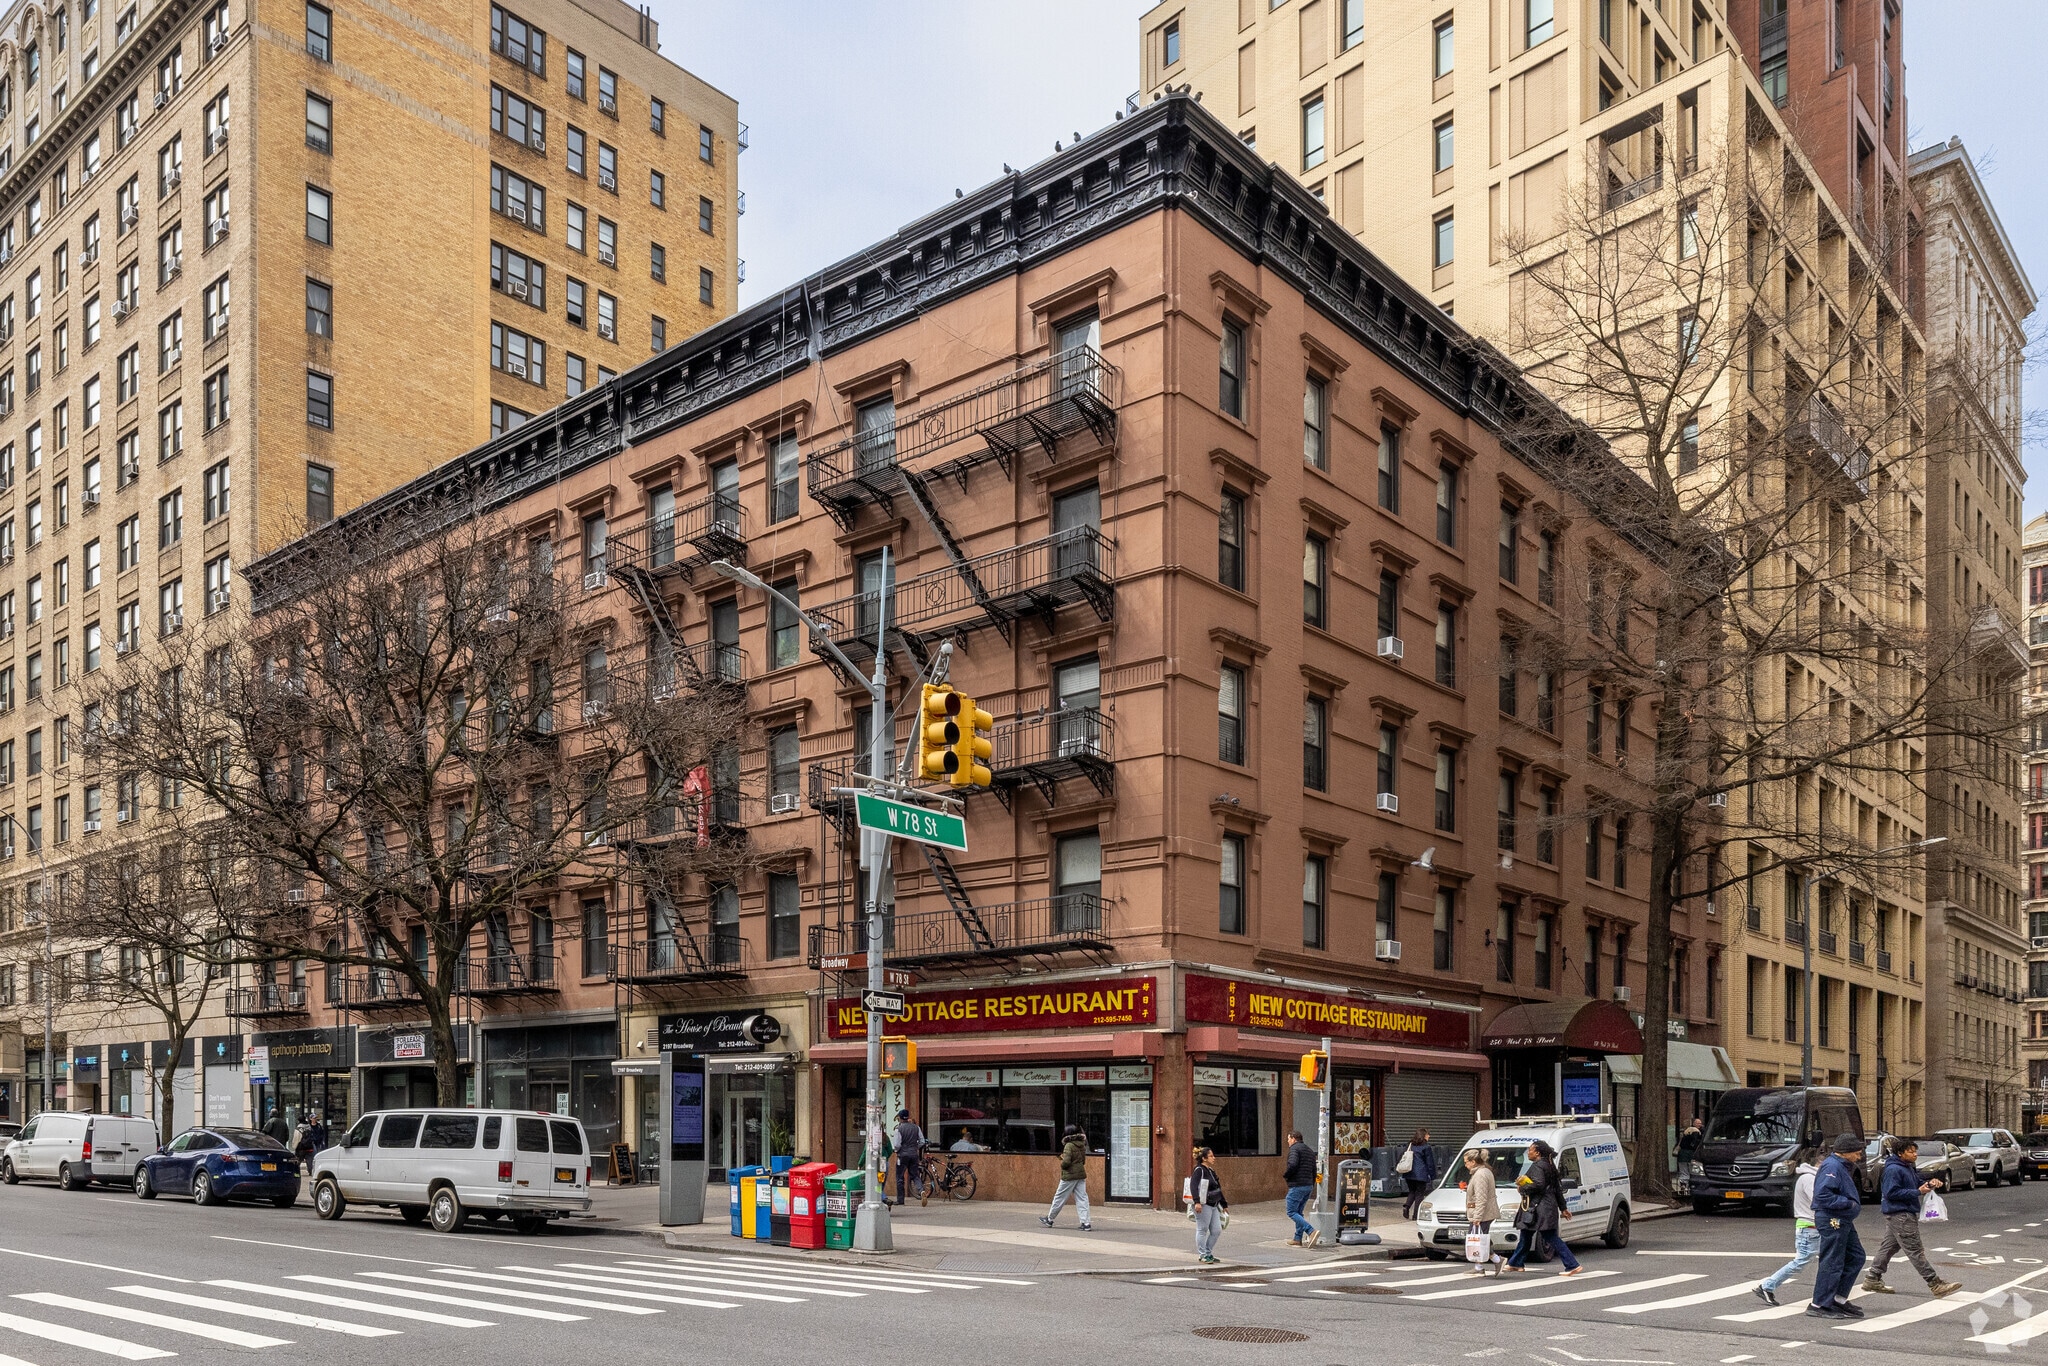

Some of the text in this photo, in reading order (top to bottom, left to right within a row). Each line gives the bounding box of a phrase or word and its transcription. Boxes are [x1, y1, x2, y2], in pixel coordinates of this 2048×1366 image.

[887, 806, 938, 838] W 78 St
[821, 957, 849, 969] Broadway
[889, 972, 910, 985] W 78 St
[868, 996, 899, 1009] ONE WAY
[984, 989, 1139, 1018] RESTAURANT
[1250, 993, 1428, 1034] NEW COTTAGE RESTAURANT
[662, 1024, 674, 1035] The
[675, 1018, 703, 1034] House
[703, 1020, 714, 1037] of
[1489, 1036, 1556, 1046] 250 West 78 Street
[271, 1042, 333, 1058] apthorp pharmacy
[950, 1073, 976, 1085] Cottage
[1024, 1071, 1051, 1082] Cottage
[1118, 1070, 1145, 1081] Cottage
[1202, 1070, 1221, 1082] Cottage
[1248, 1073, 1267, 1086] Cottage
[1583, 1144, 1618, 1156] Cool Breeze
